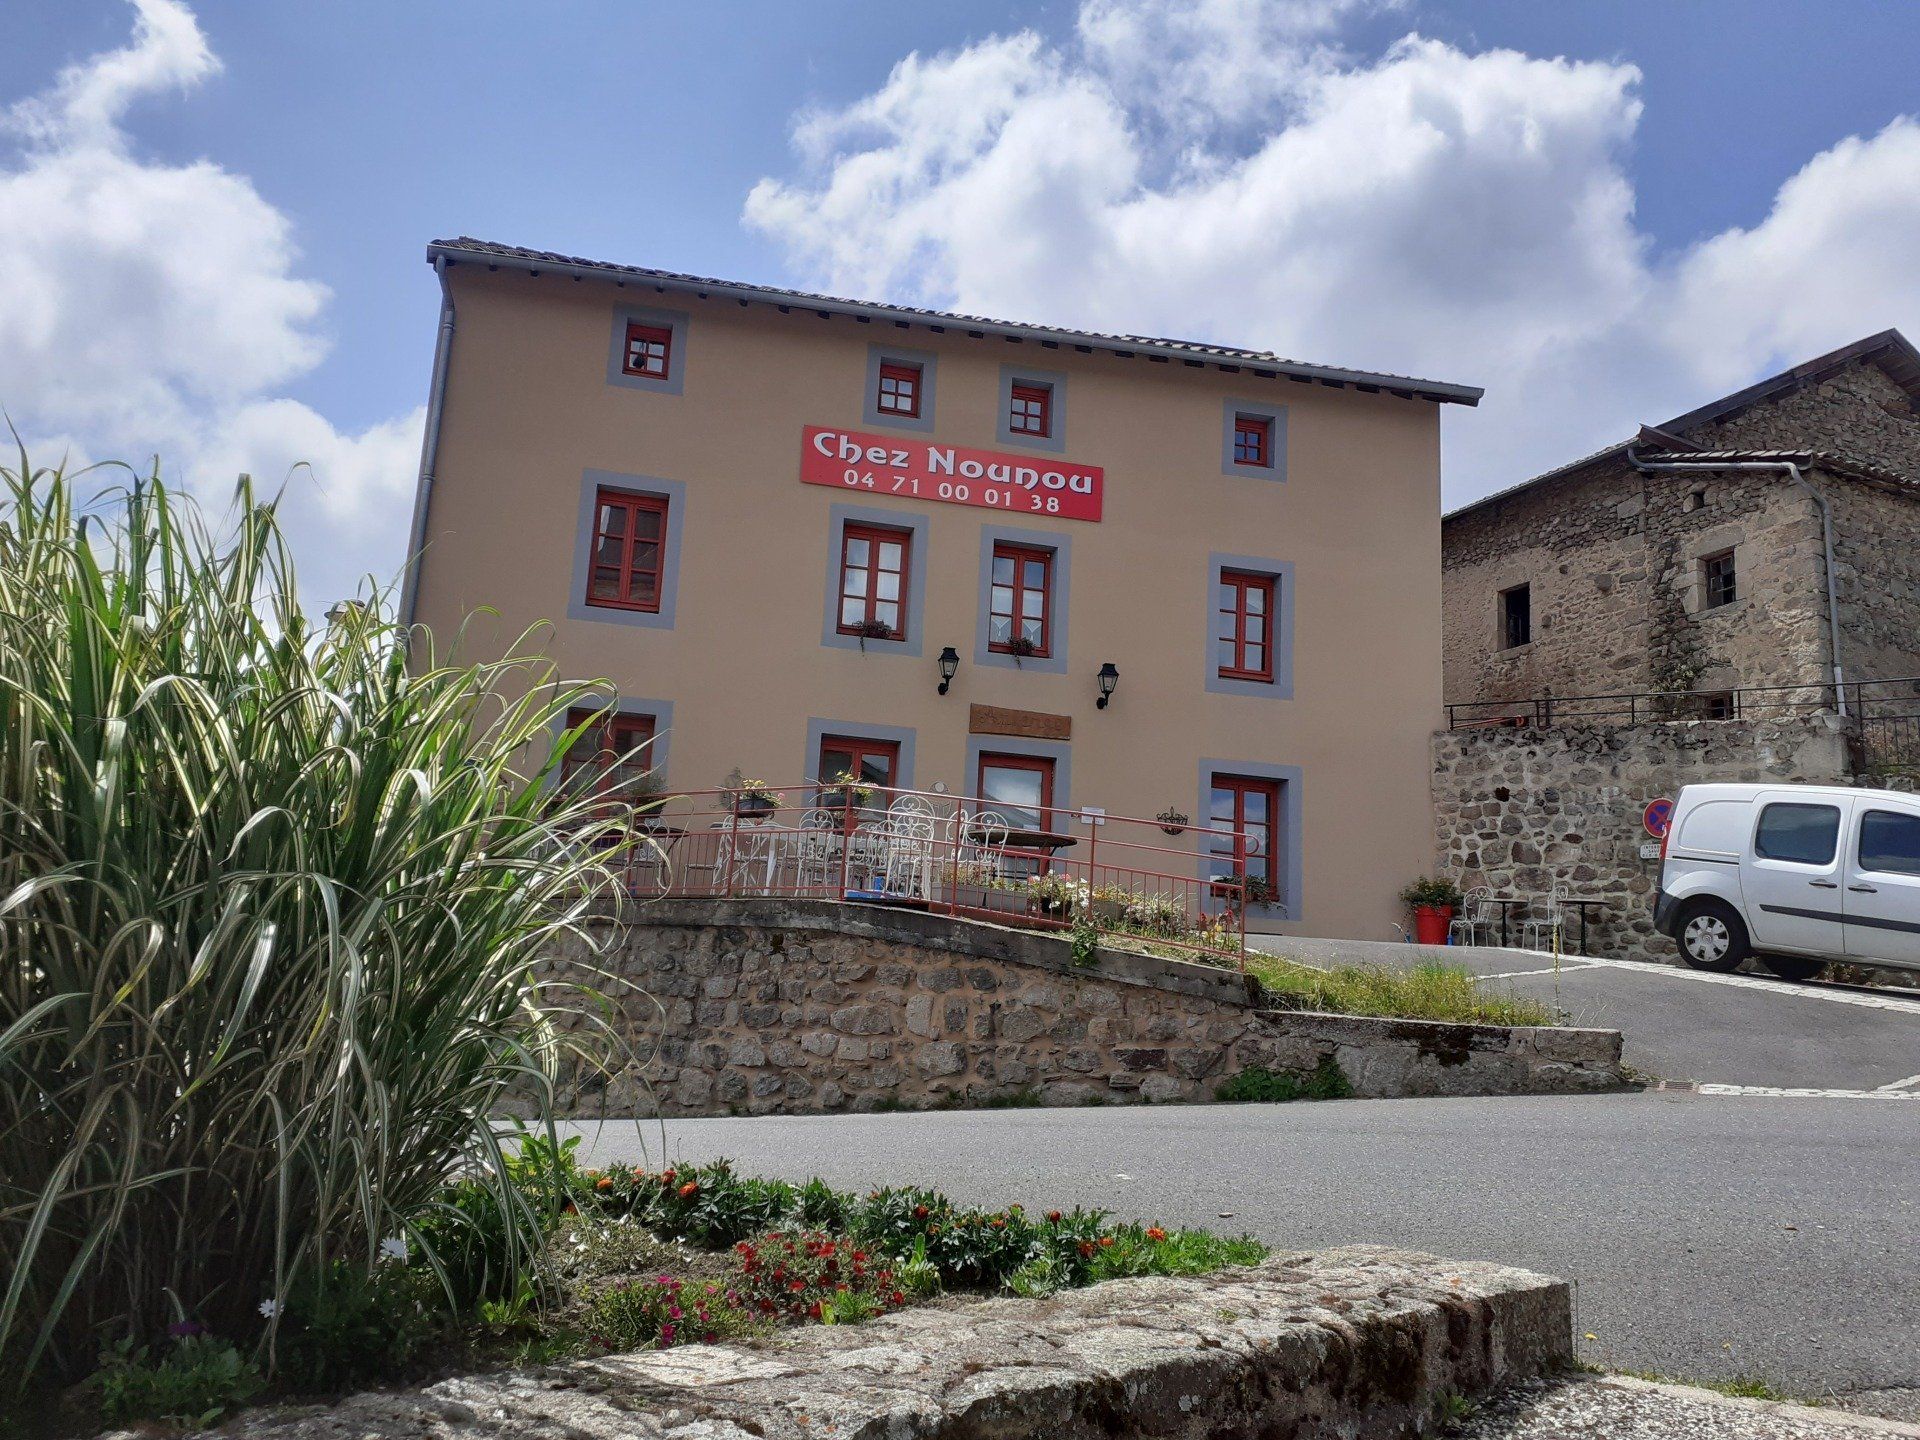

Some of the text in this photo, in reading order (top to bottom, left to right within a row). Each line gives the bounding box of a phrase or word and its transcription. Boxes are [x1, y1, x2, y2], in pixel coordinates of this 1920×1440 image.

[813, 432, 1093, 495] Chez Nounou
[843, 469, 1060, 513] 04 71 00 01 38
